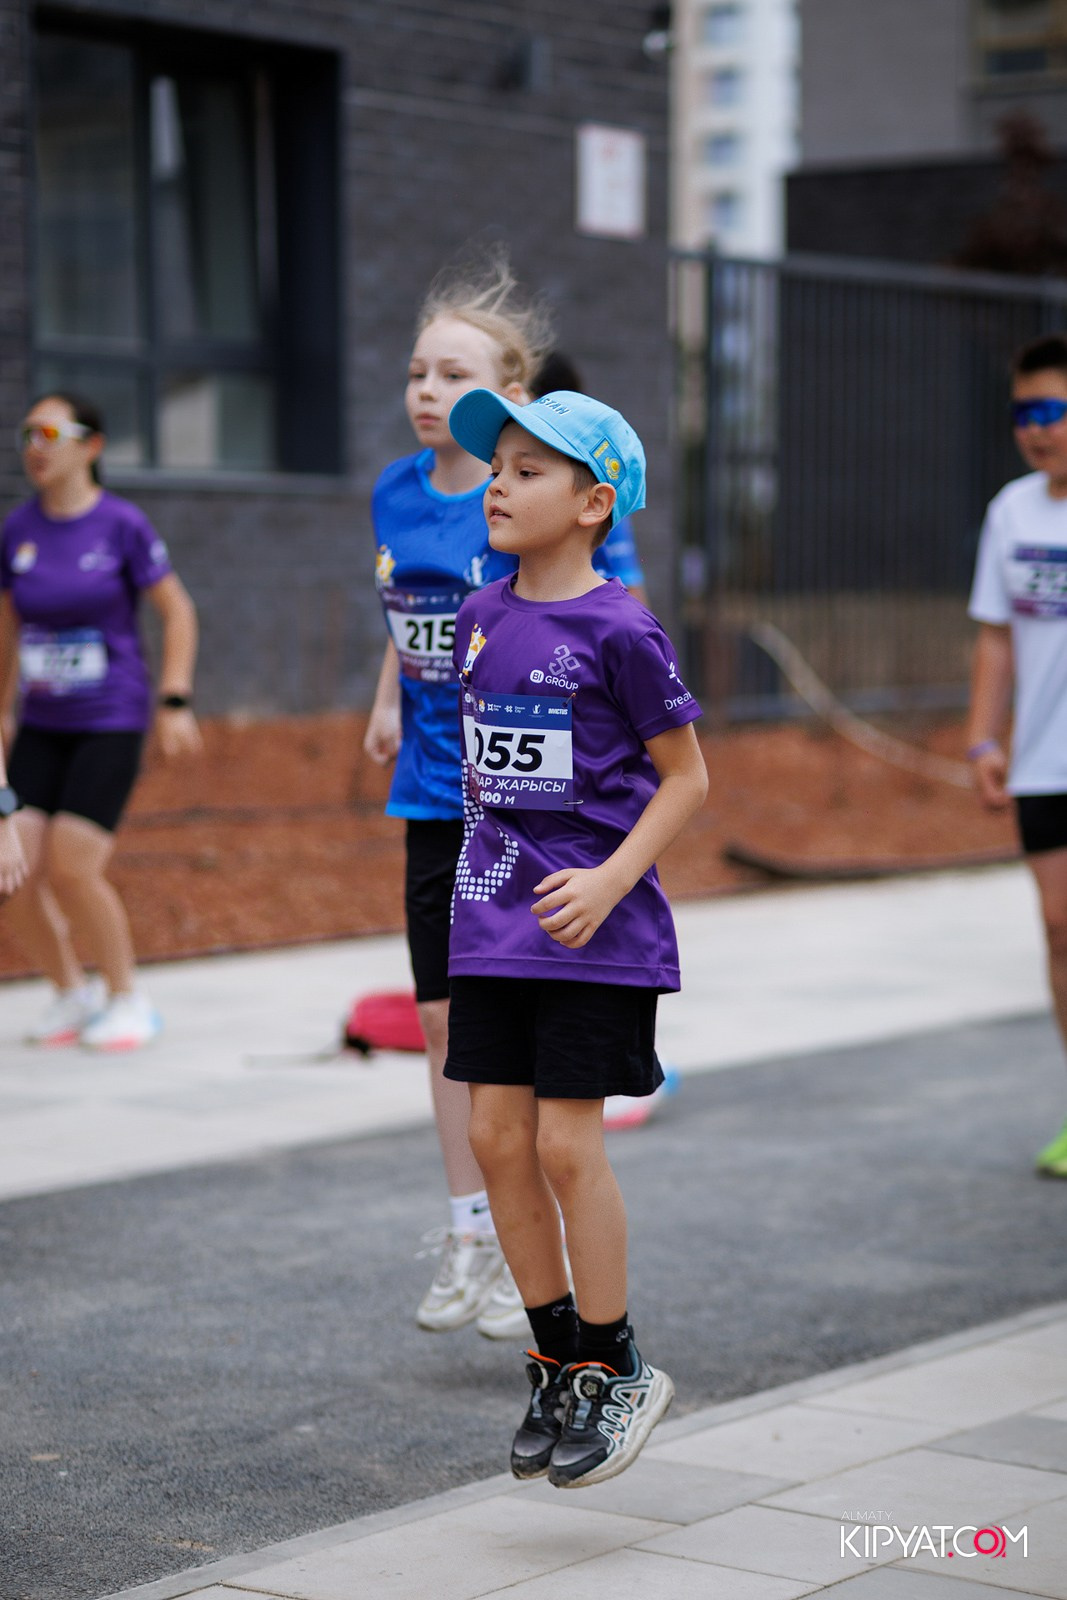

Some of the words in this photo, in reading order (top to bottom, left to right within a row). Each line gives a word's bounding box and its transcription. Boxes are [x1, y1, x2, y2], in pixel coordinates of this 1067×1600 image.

[536, 396, 570, 415] STAN
[406, 619, 456, 651] 215
[545, 675, 579, 690] GROUP
[494, 778, 566, 793] ЖАРЫСЫ
[479, 790, 502, 804] 600
